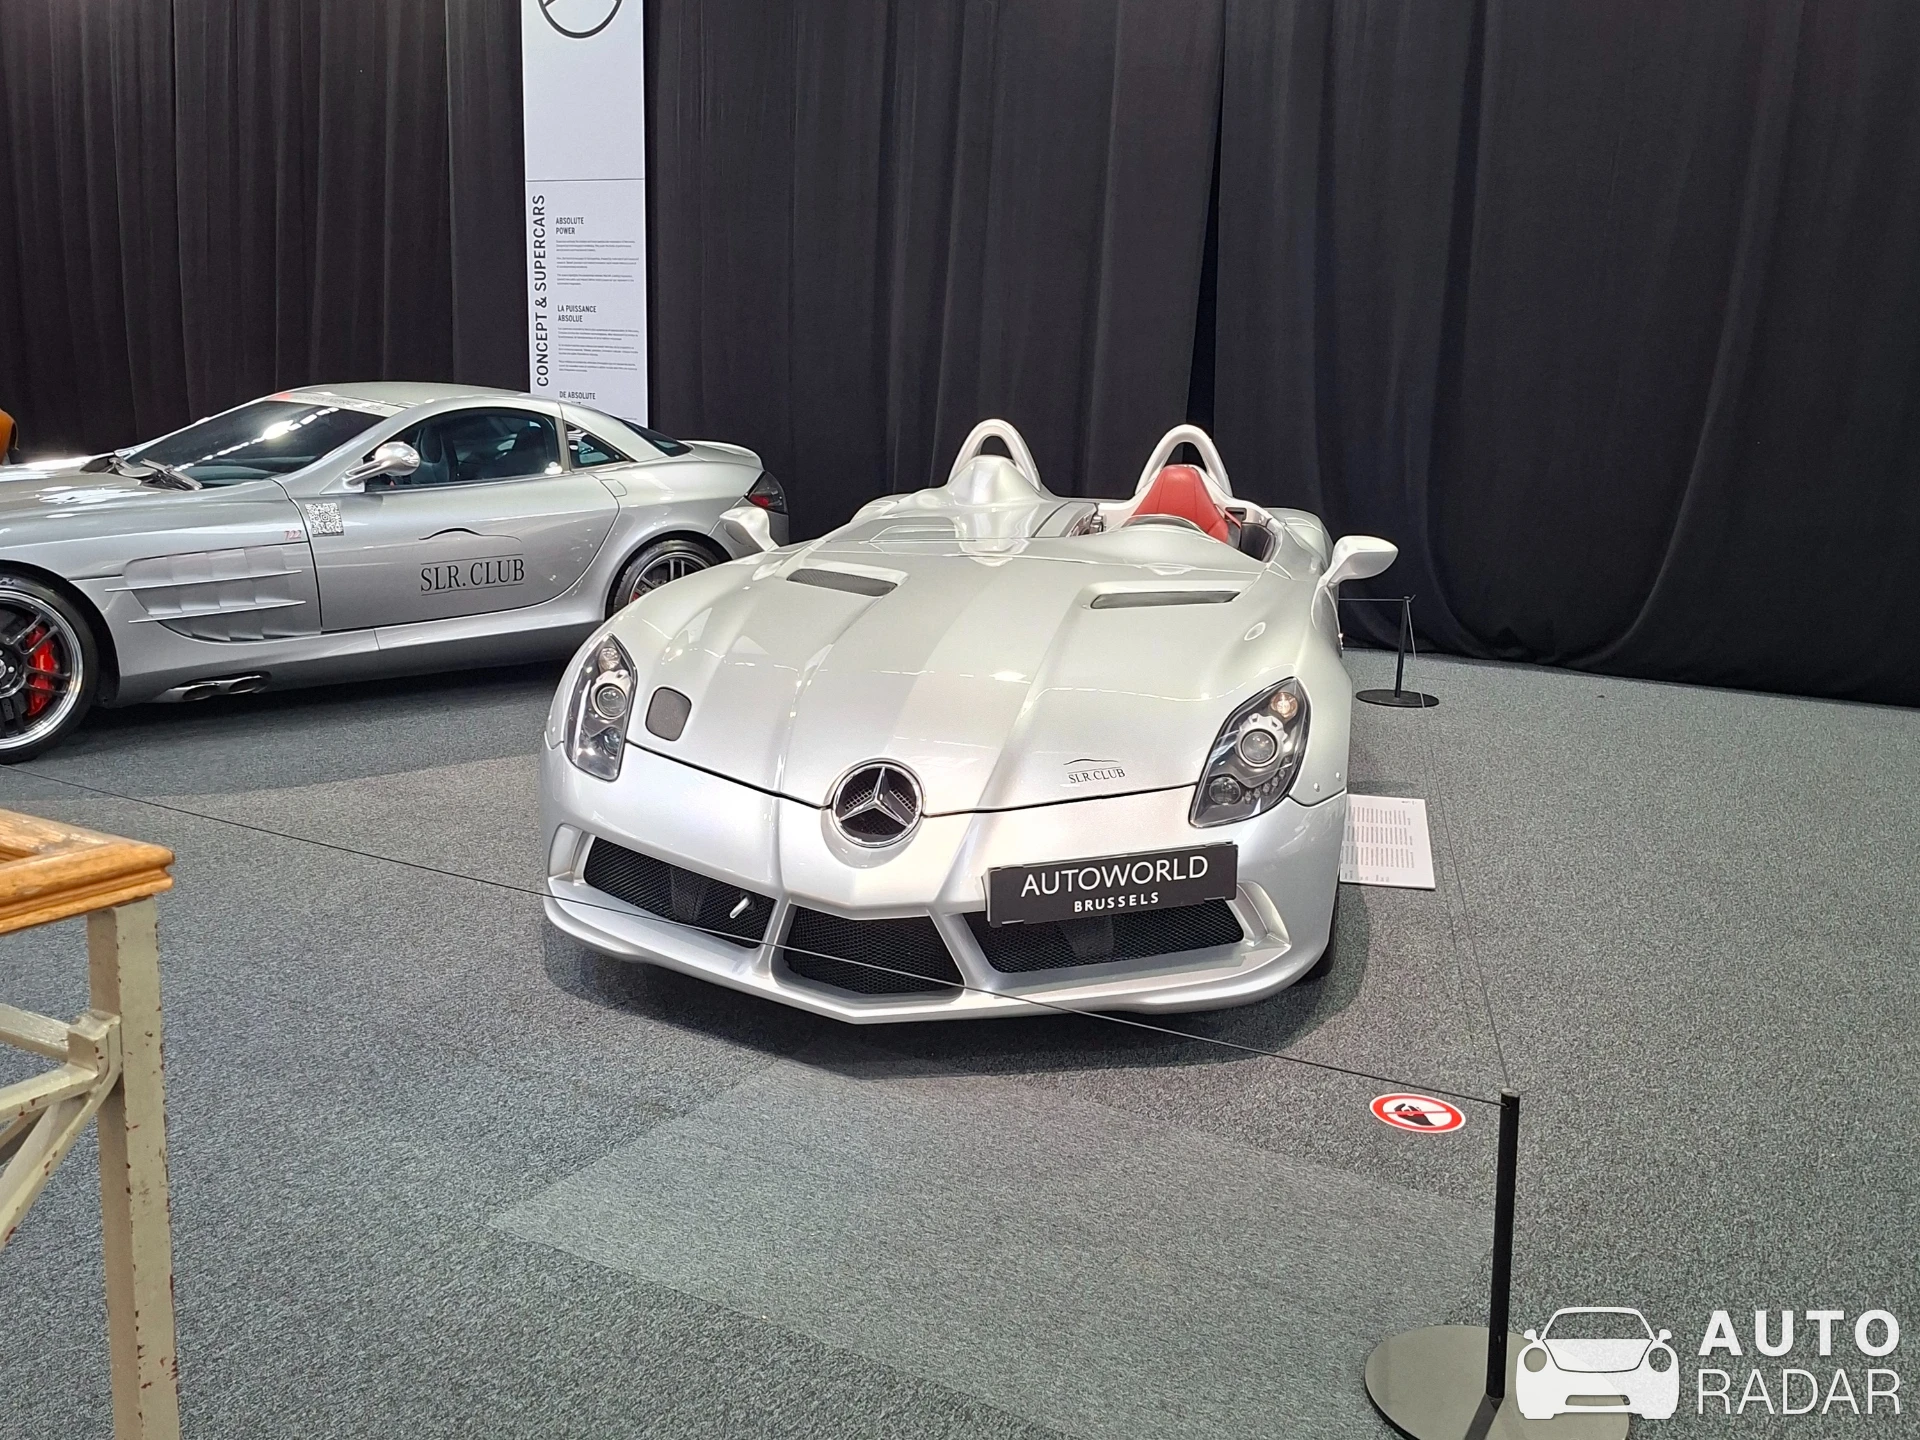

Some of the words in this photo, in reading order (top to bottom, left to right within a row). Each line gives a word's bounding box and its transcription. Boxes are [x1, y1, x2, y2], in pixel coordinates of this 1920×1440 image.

[555, 217, 585, 225] ABSOLUTE
[555, 227, 576, 235] POWER
[532, 194, 547, 292] SUPERCARS
[535, 296, 547, 308] &
[557, 304, 565, 313] LA
[566, 305, 597, 313] PUISSANCE
[557, 314, 583, 323] ABSOLUE
[536, 311, 549, 387] CONCEPT
[559, 390, 567, 399] DE
[567, 391, 596, 400] ABSOLUTE
[1020, 855, 1209, 898] AUTOWORLD
[1073, 891, 1159, 913] BRUSSELS
